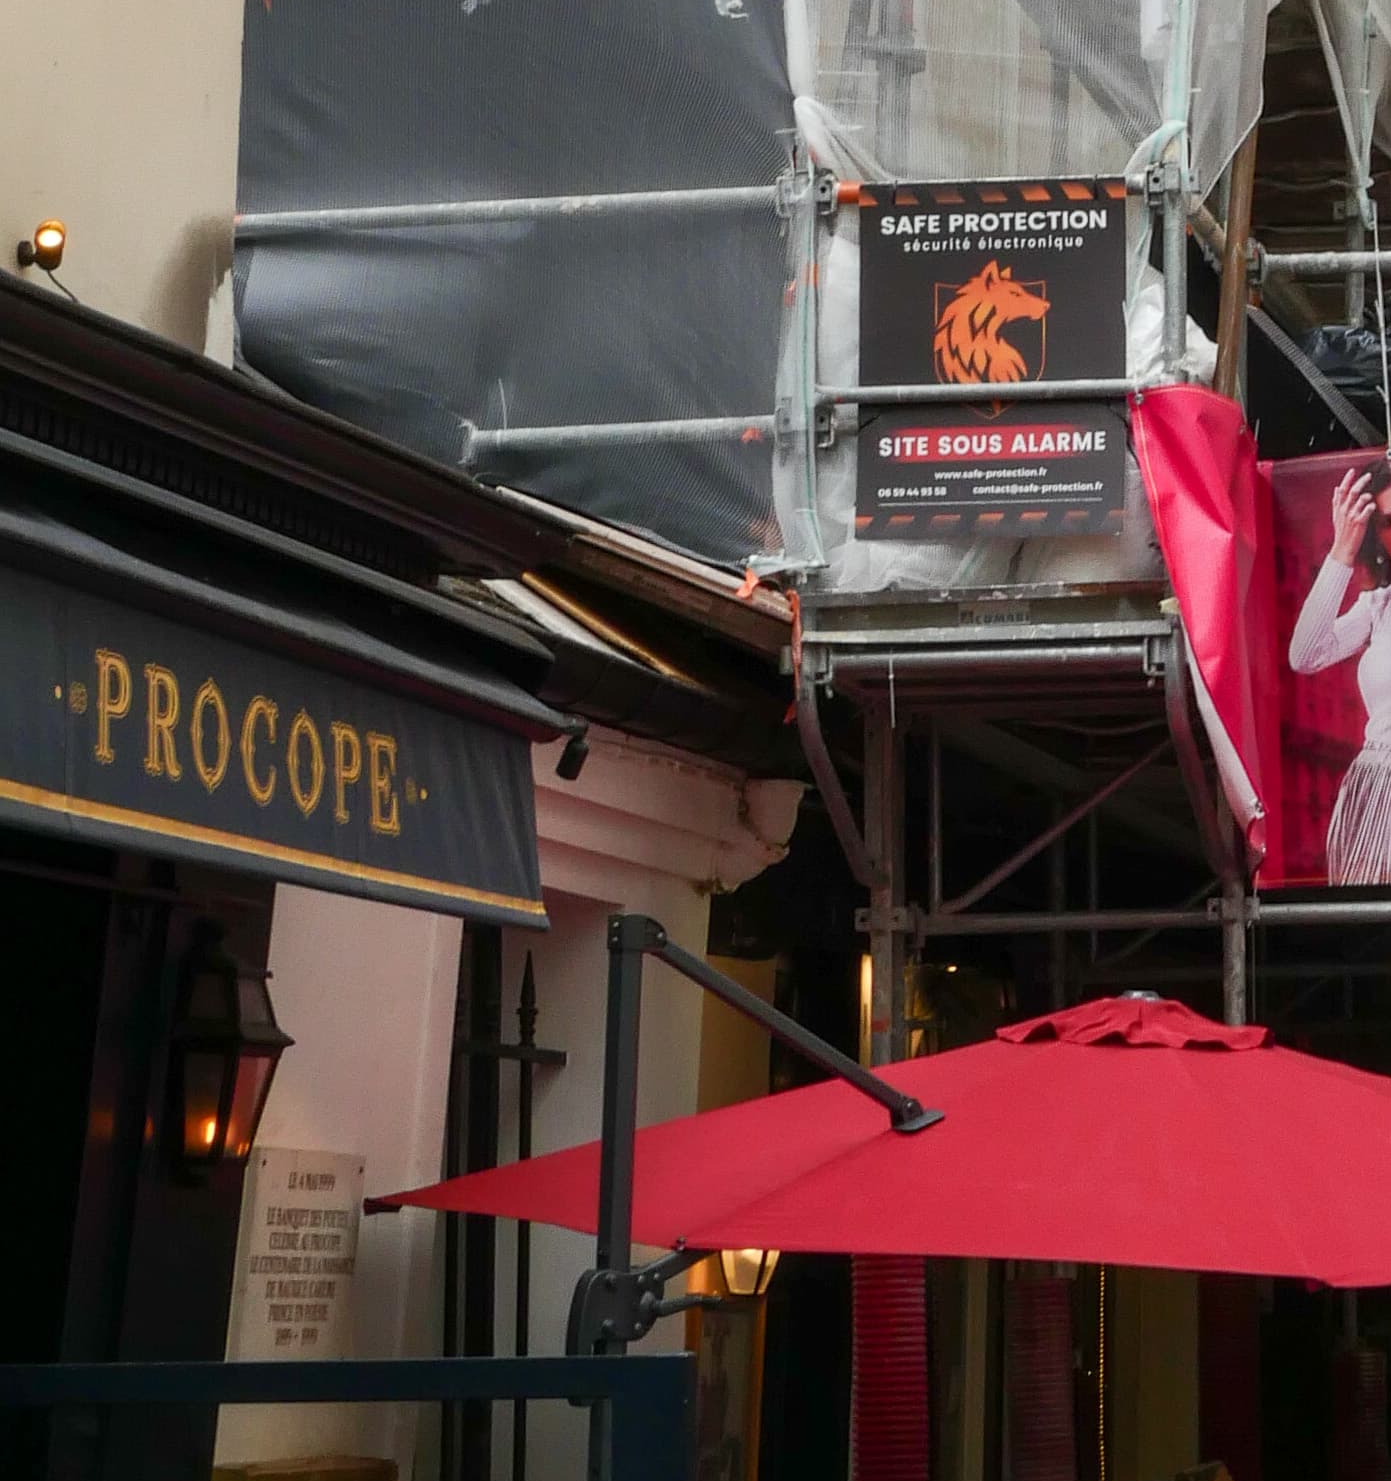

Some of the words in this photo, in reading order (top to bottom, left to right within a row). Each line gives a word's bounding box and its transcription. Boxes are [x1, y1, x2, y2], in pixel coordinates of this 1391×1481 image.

[880, 214, 941, 235] SAFE
[948, 209, 1108, 234] PROTECTION
[903, 236, 972, 253] sécurité
[977, 235, 1084, 253] électronique
[878, 434, 929, 458] SITE
[938, 433, 1002, 455] SOUS
[1010, 430, 1107, 453] ALARME
[934, 466, 1048, 481] www.safe-protection.fr
[94, 647, 401, 836] PROCOPE
